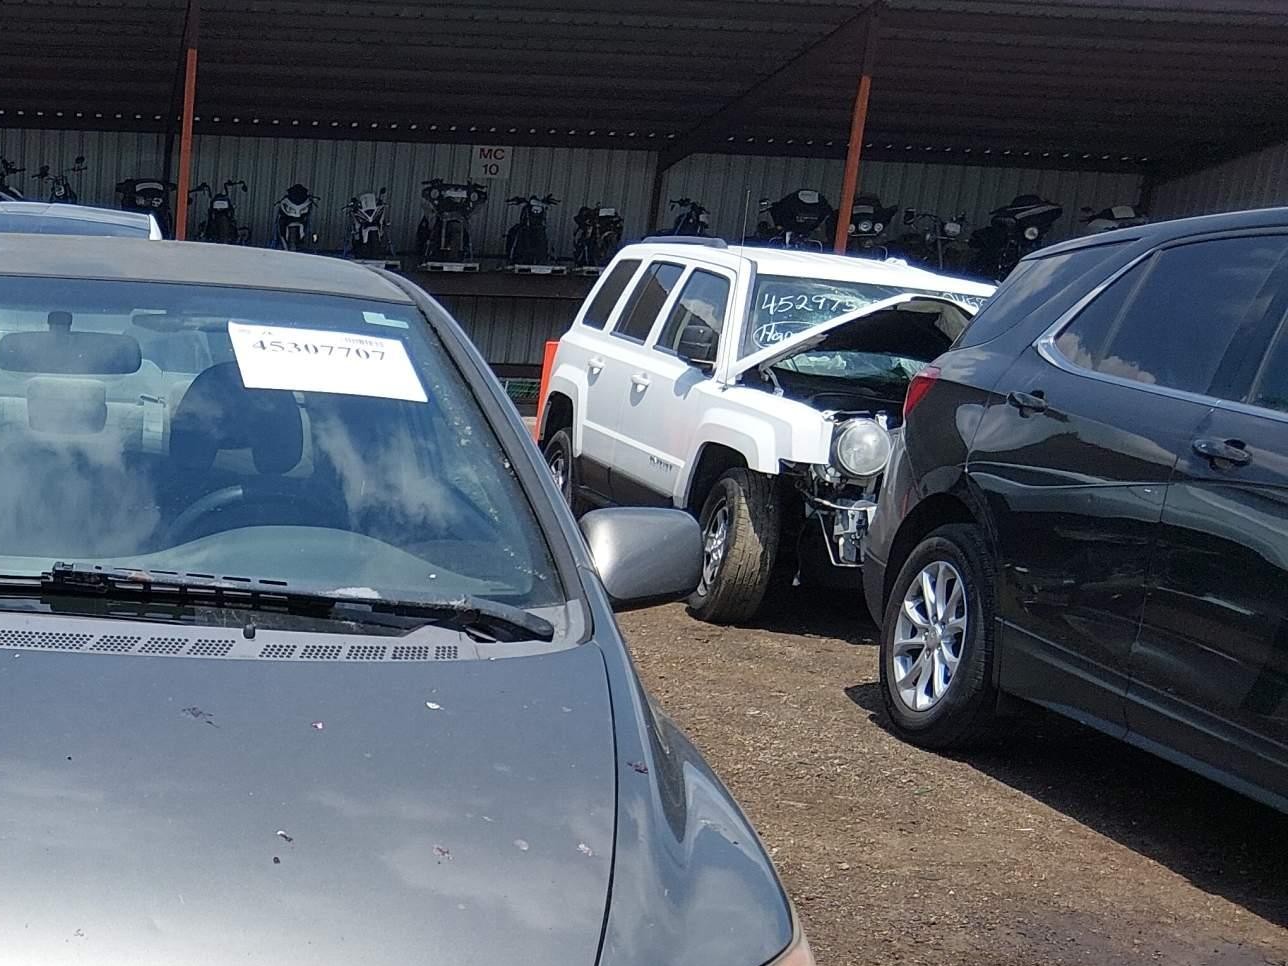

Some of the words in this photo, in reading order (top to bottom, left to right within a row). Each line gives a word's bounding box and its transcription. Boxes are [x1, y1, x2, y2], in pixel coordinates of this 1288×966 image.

[479, 147, 505, 160] MC
[481, 163, 500, 176] 10
[252, 339, 386, 361] 45307707
